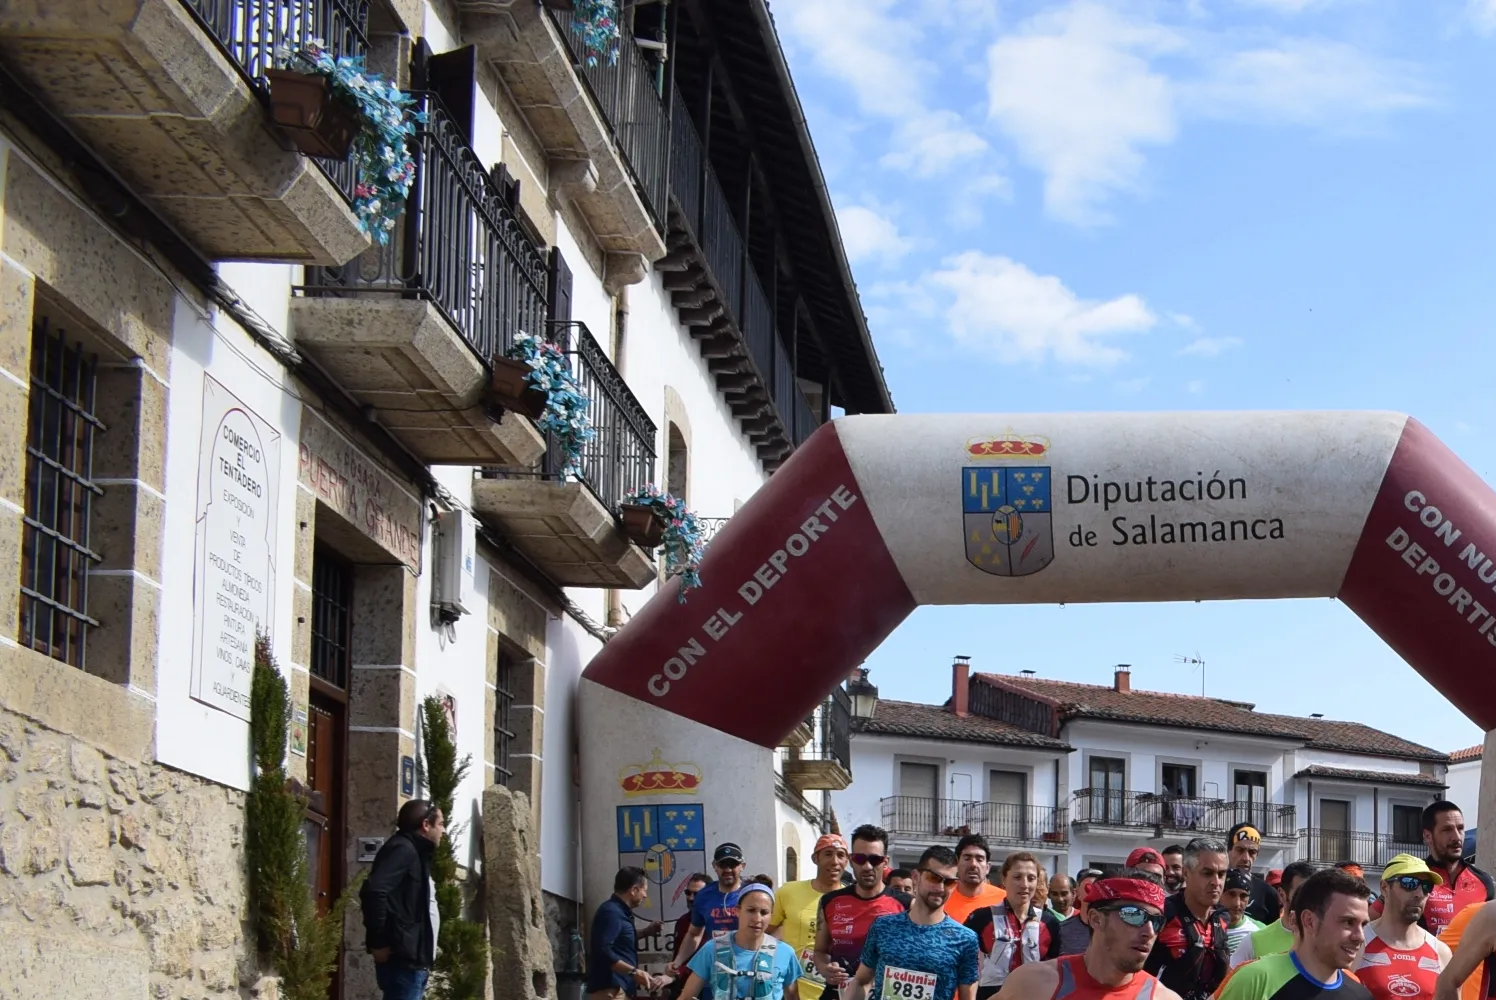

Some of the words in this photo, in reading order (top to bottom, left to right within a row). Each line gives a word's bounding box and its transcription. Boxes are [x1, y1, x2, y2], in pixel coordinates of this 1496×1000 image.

[223, 425, 260, 463] COMERCIO
[237, 453, 245, 470] EL
[219, 457, 262, 498] TENTADERO
[1067, 470, 1247, 511] Diputación
[299, 441, 358, 519] PUERTA
[366, 498, 418, 566] GRANDE
[1404, 490, 1462, 547] CON
[230, 529, 246, 549] VENTA
[1069, 524, 1098, 547] de
[1112, 514, 1285, 545] Salamanca
[209, 552, 242, 582] PRODUCTOS
[233, 549, 241, 563] DE
[222, 578, 250, 602] ALMONEDA
[647, 637, 707, 697] CON
[702, 608, 744, 642] EL
[737, 484, 858, 606] DEPORTE
[224, 614, 246, 636] PINTURA
[892, 981, 924, 1000] 983
